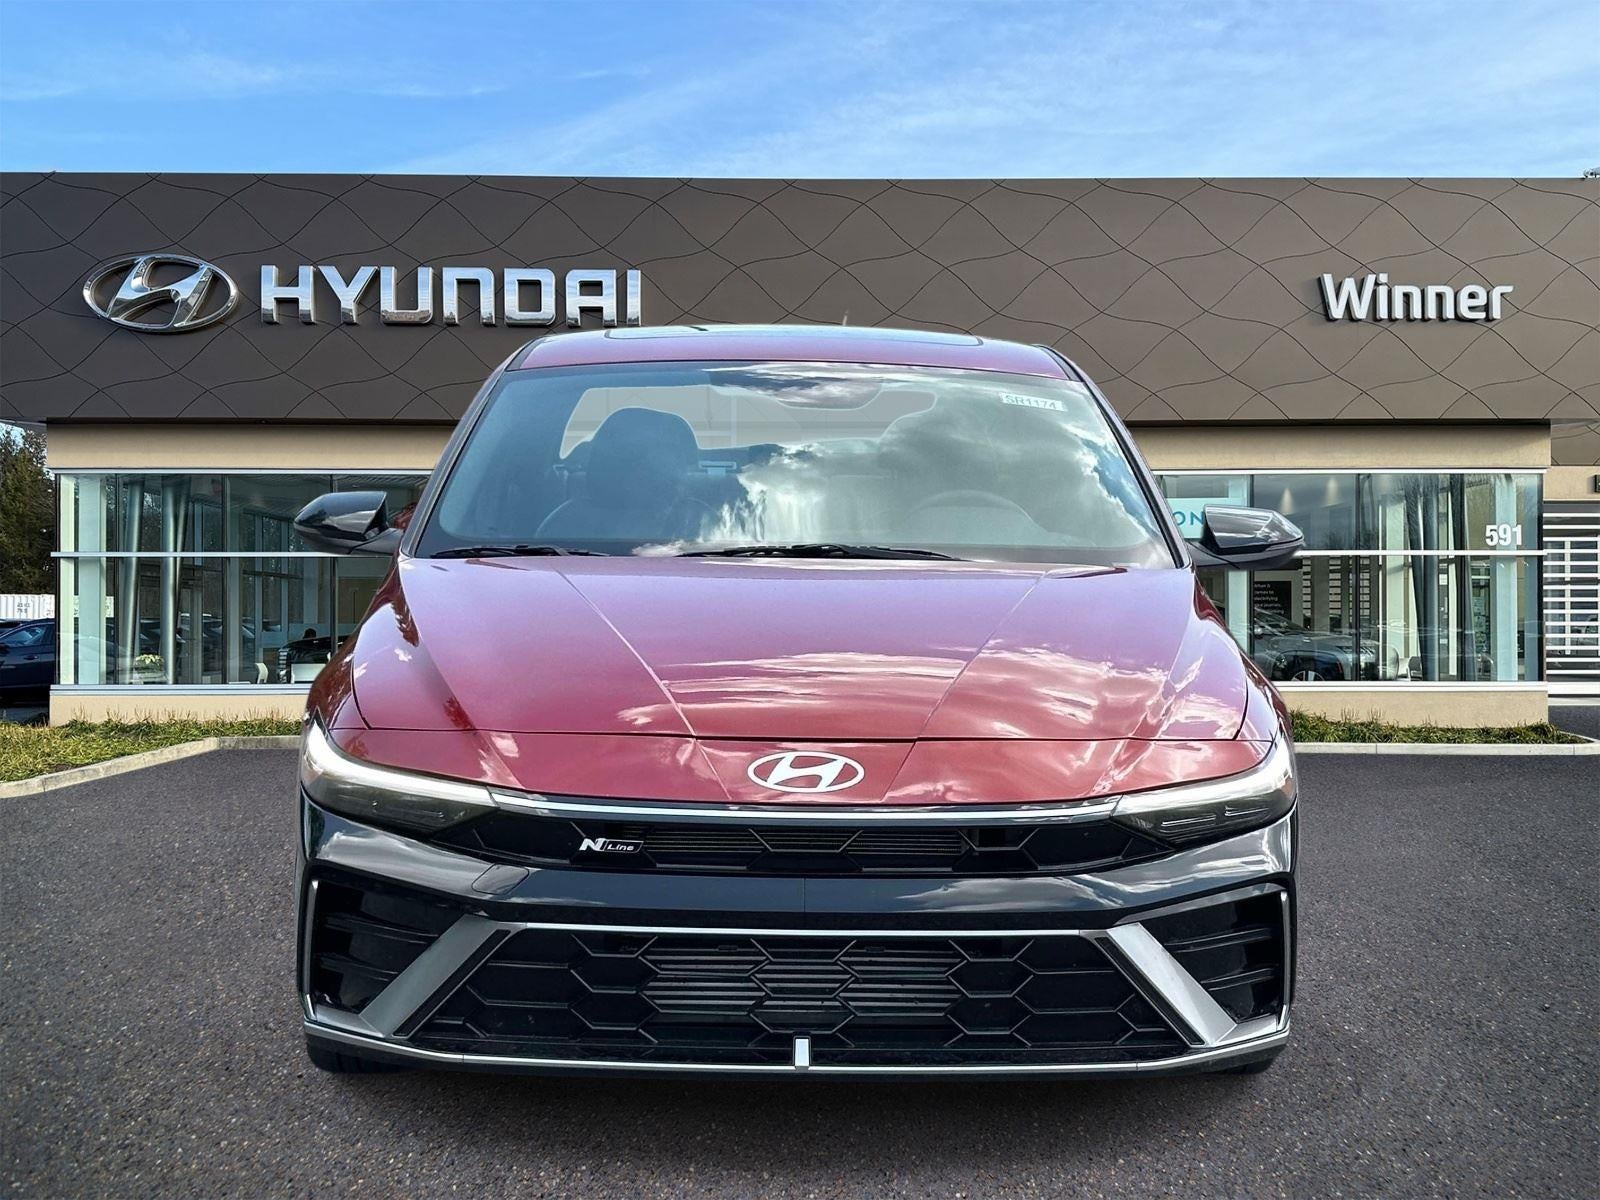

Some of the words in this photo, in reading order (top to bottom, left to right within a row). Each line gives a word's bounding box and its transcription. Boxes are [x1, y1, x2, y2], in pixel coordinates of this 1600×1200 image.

[260, 264, 642, 327] HYUNDAI
[1319, 272, 1515, 321] Winner
[1485, 523, 1522, 546] 591
[579, 838, 605, 852] N
